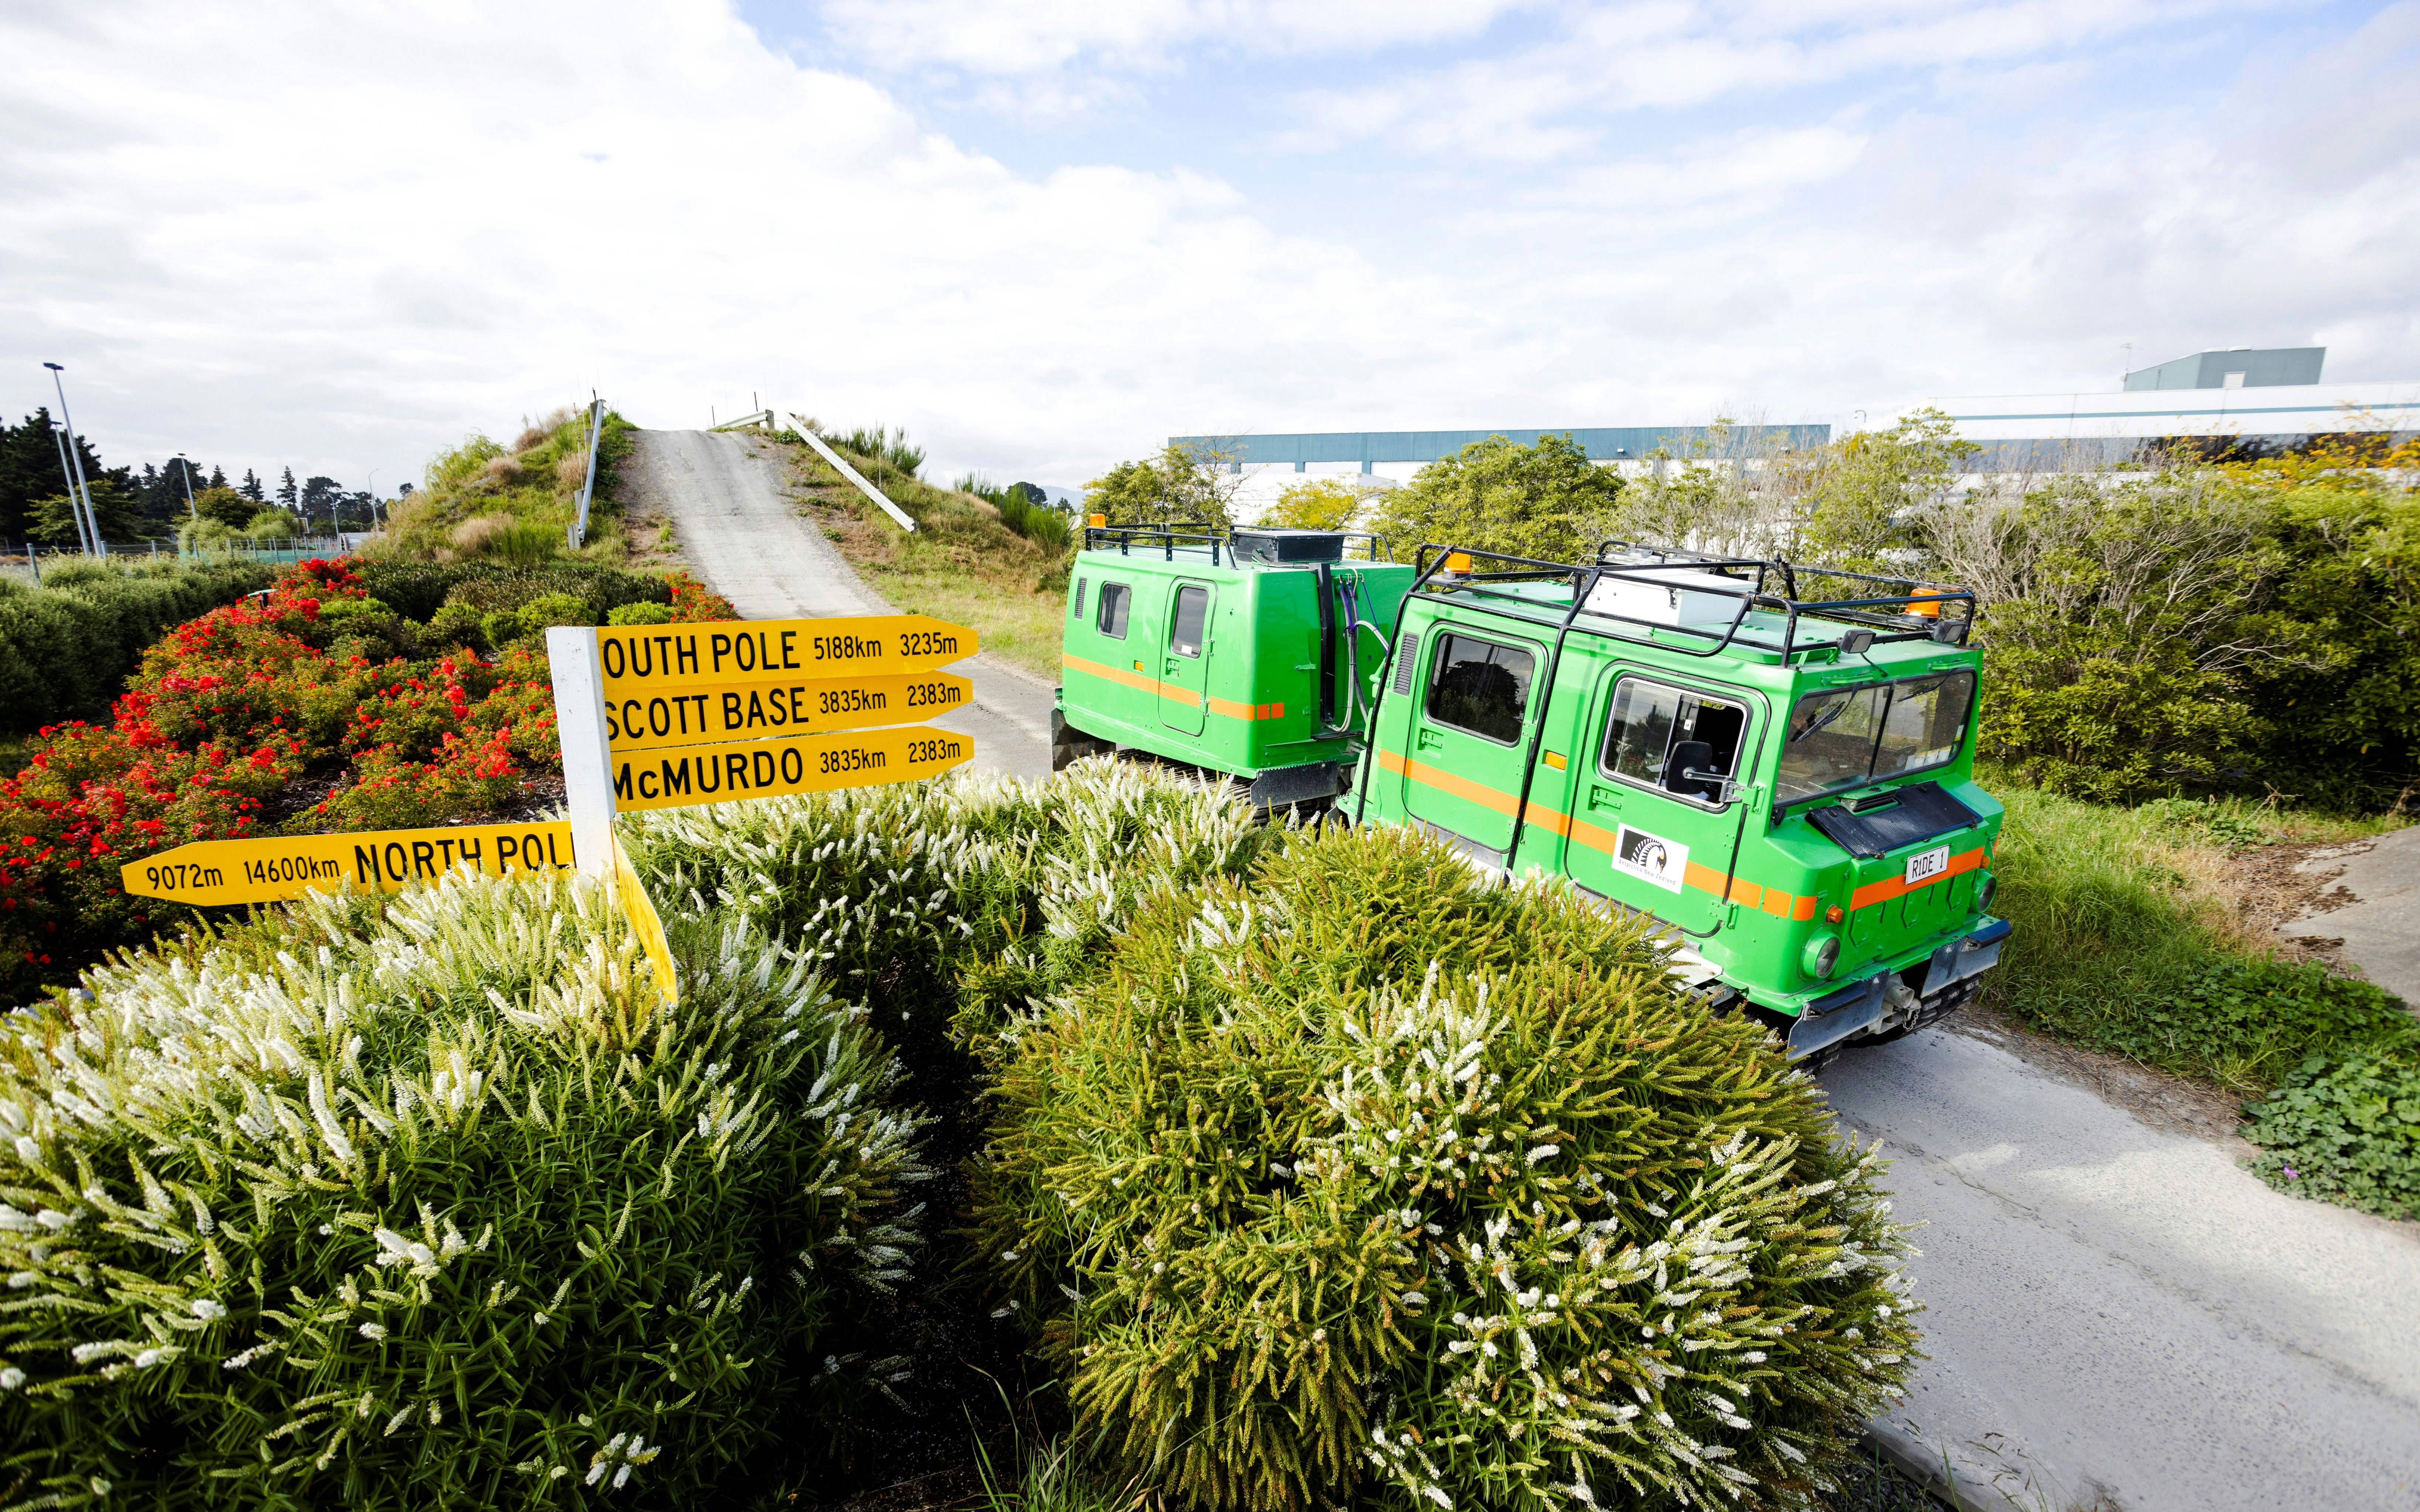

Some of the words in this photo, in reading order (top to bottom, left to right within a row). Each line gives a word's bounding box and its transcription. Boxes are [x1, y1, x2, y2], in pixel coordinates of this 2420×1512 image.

[603, 635, 699, 678] OUTH
[711, 631, 800, 673] POLE
[814, 636, 881, 660] 5188km
[900, 632, 957, 656] 3235m
[604, 694, 709, 741] SCOTT
[722, 687, 809, 730] BASE
[819, 689, 886, 714] 3835km
[907, 683, 960, 706] 2383m
[612, 748, 803, 800] McMURDO
[820, 749, 885, 773] 3835km
[908, 739, 960, 763] 2383m
[147, 863, 223, 890] 9072m
[244, 856, 340, 884] 14600km
[354, 838, 482, 883] NORTH
[1618, 859, 1642, 872] Antarctica
[1644, 869, 1654, 877] New
[1656, 873, 1676, 885] Zealand
[1940, 851, 1943, 869] 1
